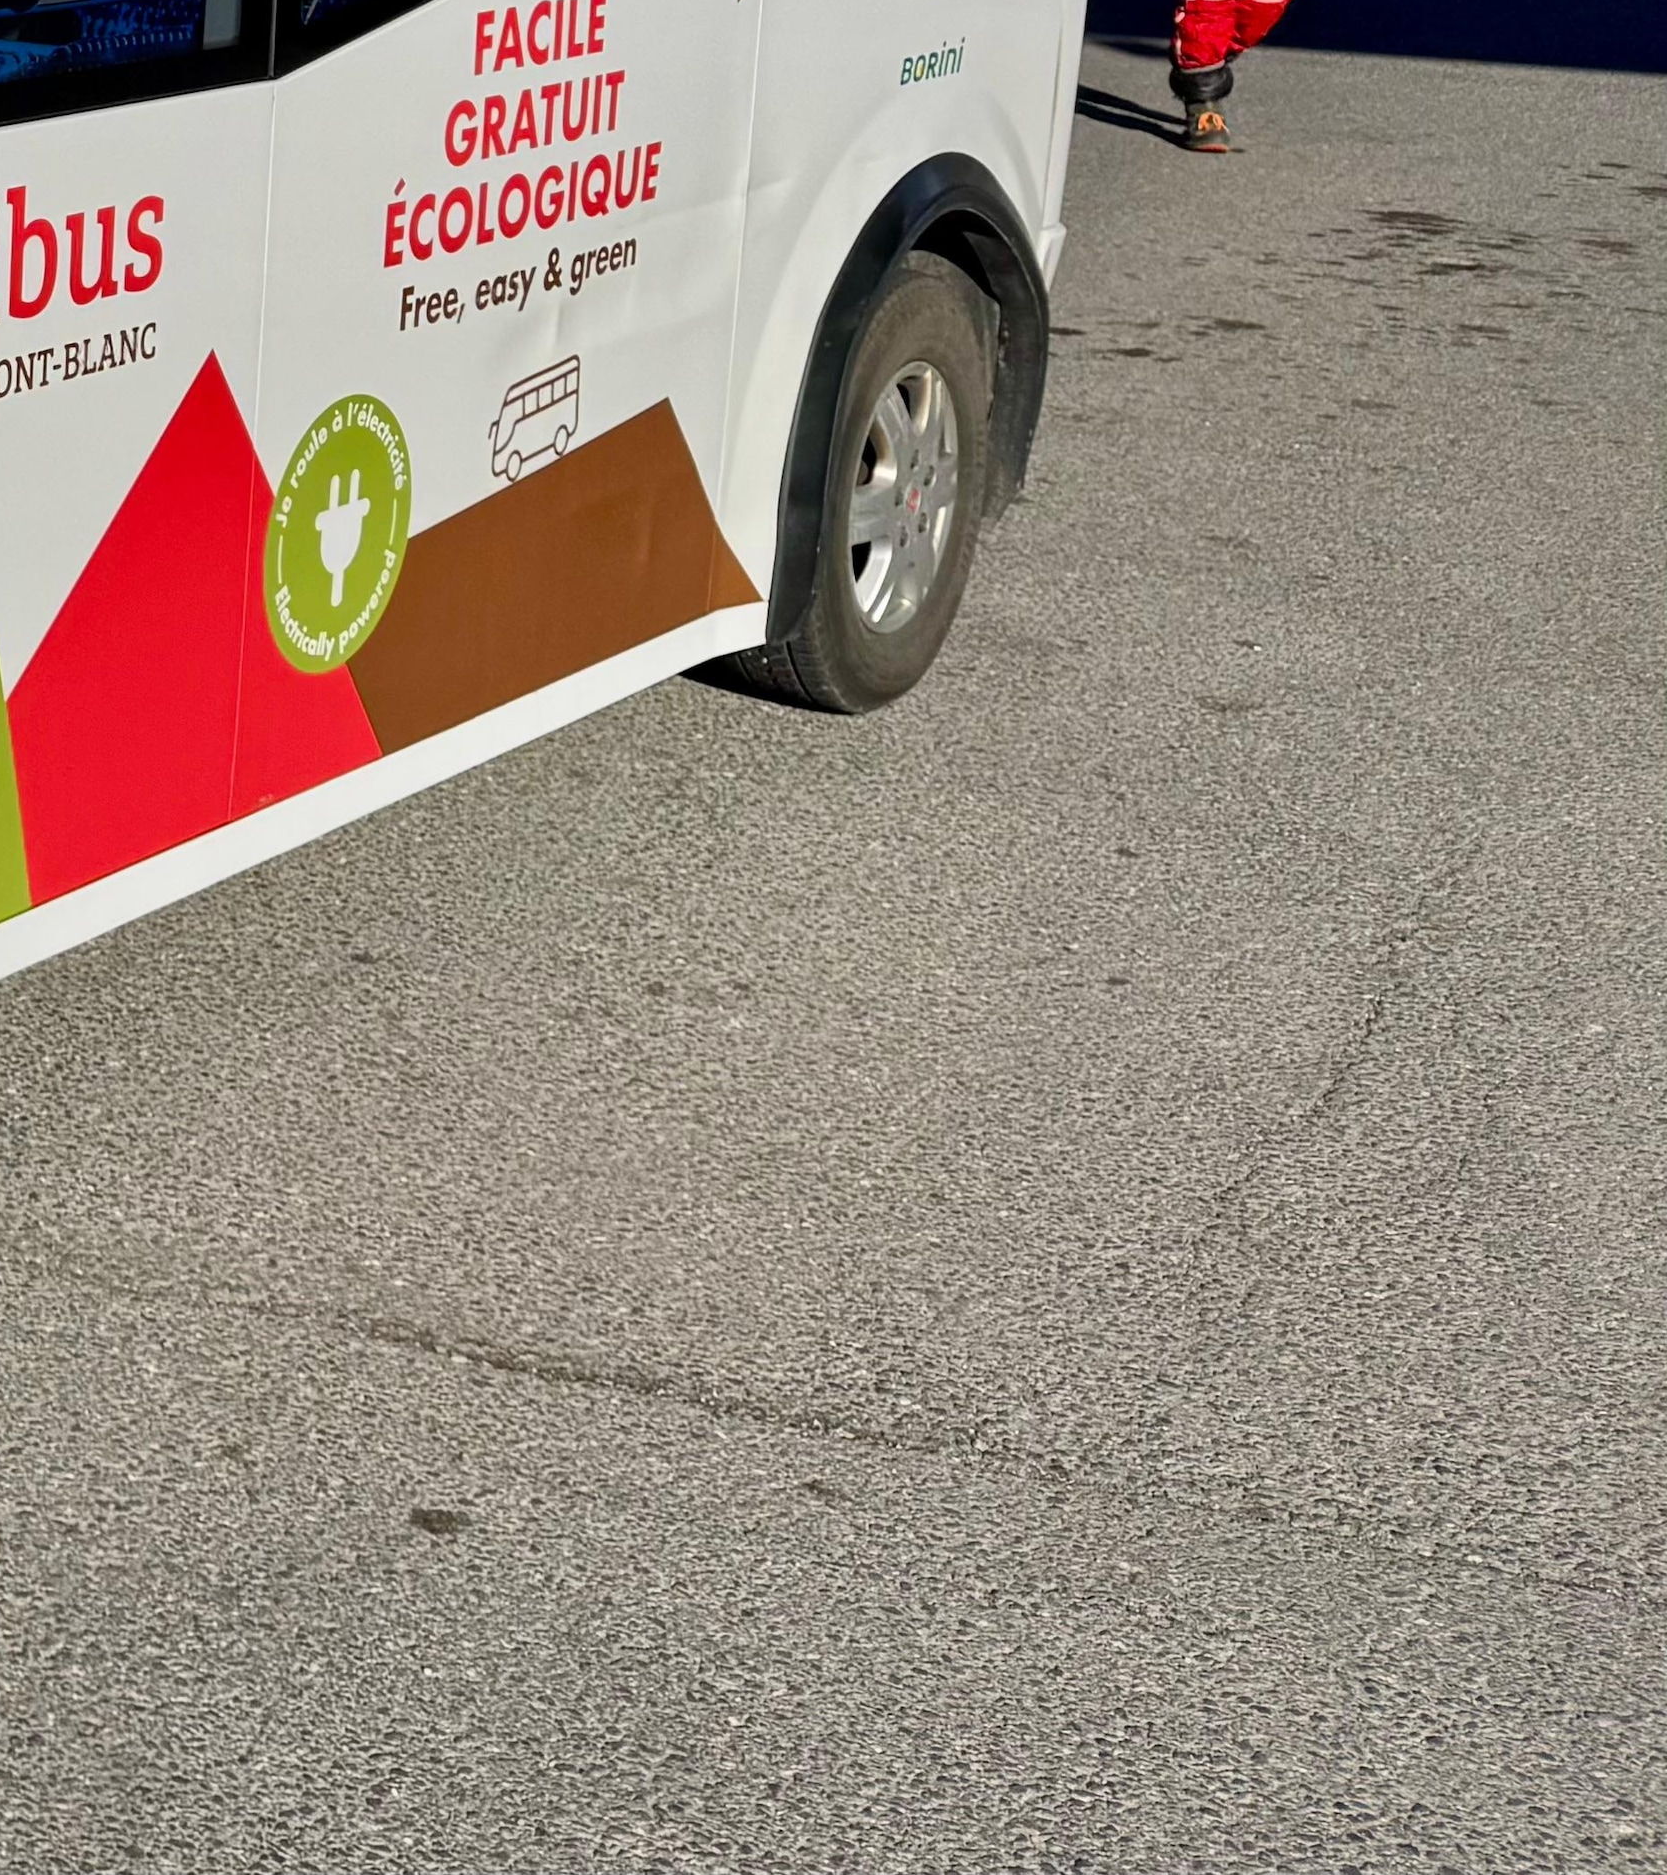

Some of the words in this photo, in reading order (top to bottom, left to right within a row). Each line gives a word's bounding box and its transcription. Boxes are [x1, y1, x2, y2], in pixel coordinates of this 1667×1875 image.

[444, 69, 625, 167] GRATUIT
[383, 141, 662, 269] ÉCOLOGIQUE
[399, 285, 465, 331] Free,
[475, 266, 537, 312] easy
[543, 247, 563, 291] &
[569, 237, 637, 297] green
[275, 495, 293, 528] Je
[289, 425, 328, 489] roule
[331, 409, 343, 433] à
[275, 584, 335, 662] Electrically
[339, 547, 397, 654] powered
